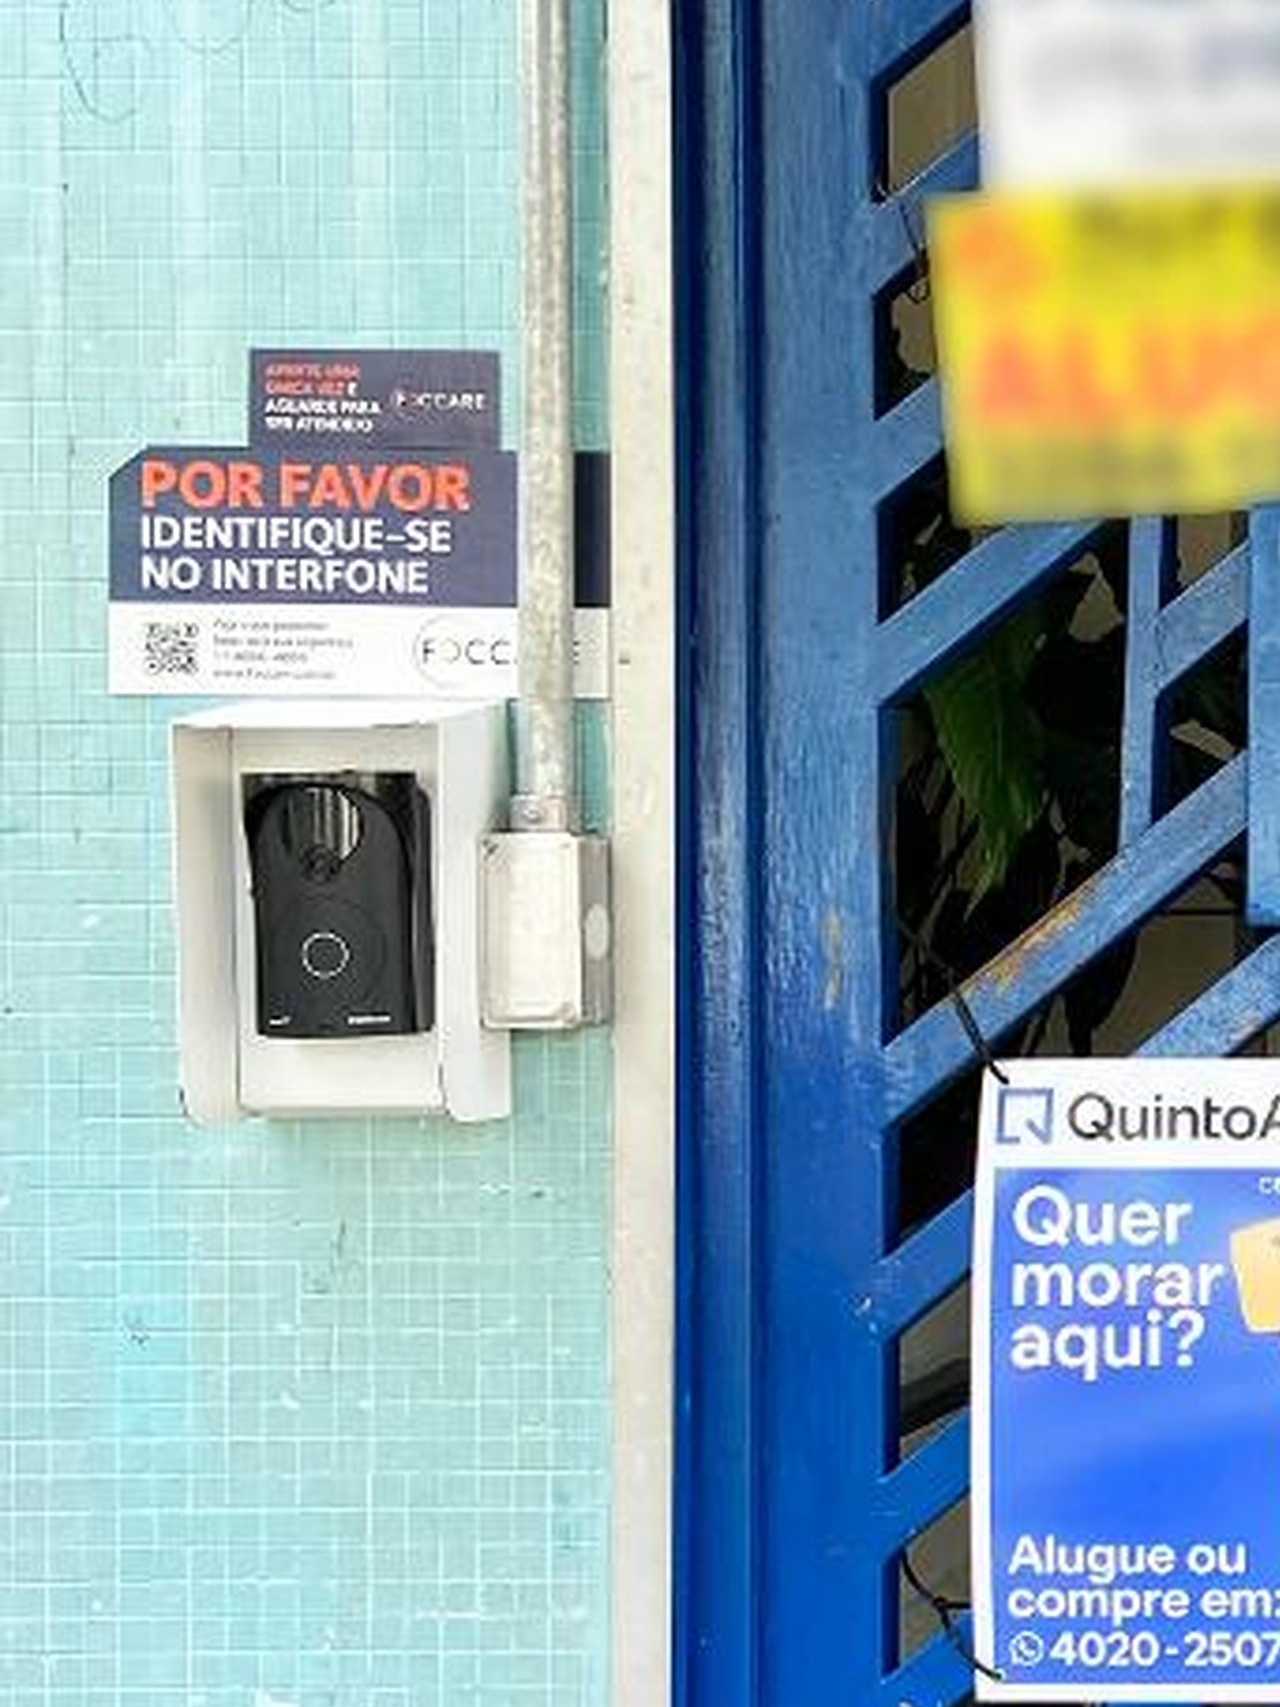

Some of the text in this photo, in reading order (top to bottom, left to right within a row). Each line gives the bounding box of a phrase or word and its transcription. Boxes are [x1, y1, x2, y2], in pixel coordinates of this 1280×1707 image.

[141, 460, 470, 511] POR FAVOR
[141, 516, 452, 555] IDENTIFIQUE-SE
[141, 556, 429, 593] NO INTERFONE
[1012, 1185, 1194, 1248] Quer
[1011, 1258, 1225, 1306] morar
[1010, 1310, 1206, 1381] aqui?
[1008, 1534, 1247, 1585] Alugue ou
[1007, 1588, 1191, 1627] compre
